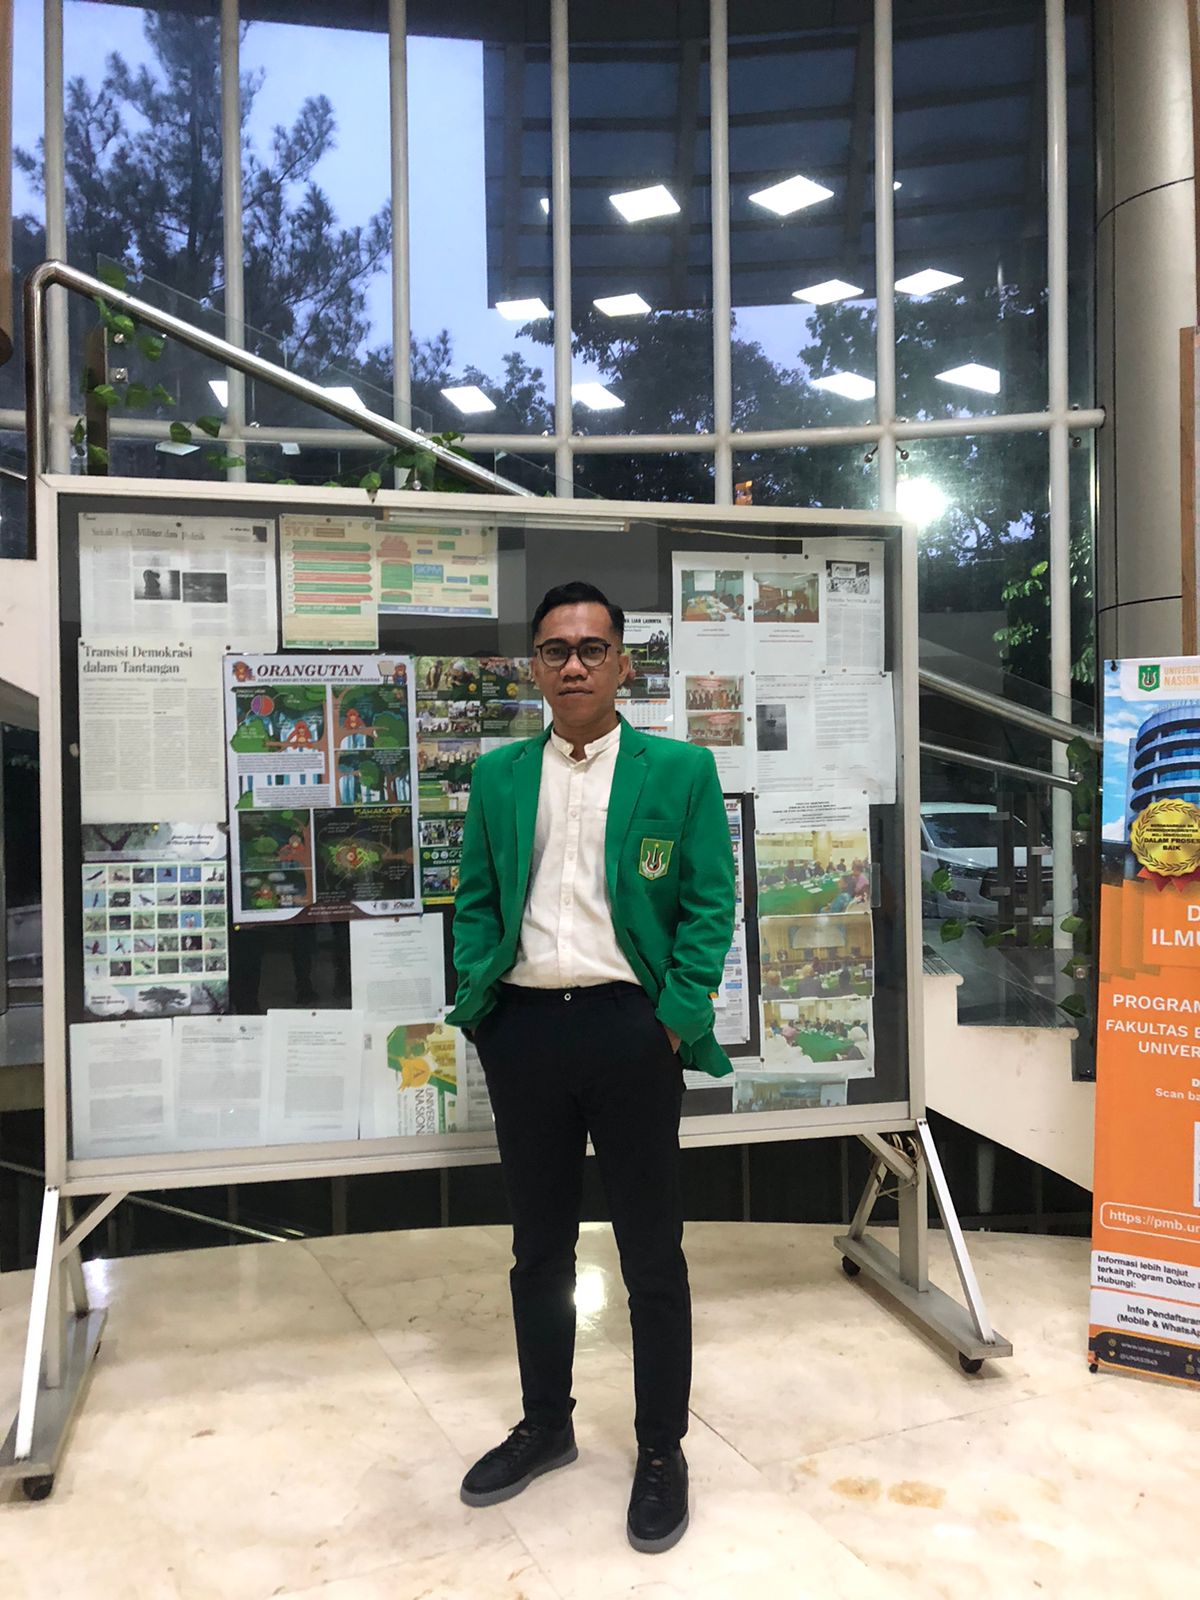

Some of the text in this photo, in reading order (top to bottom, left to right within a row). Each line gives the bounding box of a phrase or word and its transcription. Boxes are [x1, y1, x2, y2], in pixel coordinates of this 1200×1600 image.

[83, 645, 193, 658] Transisi Demokrasi
[82, 660, 180, 674] dalam Tantangan
[256, 663, 363, 677] ORANGUTAN
[1152, 927, 1200, 947] ILM
[1106, 1019, 1189, 1038] FAKULTAS
[1154, 1087, 1185, 1100] Scan
[1097, 1255, 1189, 1277] Informasi lebih lanjut
[1097, 1265, 1125, 1277] terkait
[1126, 1269, 1164, 1282] Program
[1166, 1276, 1196, 1289] Doktor
[1097, 1275, 1137, 1289] Hubungi:
[1127, 1304, 1145, 1315] Info
[1116, 1313, 1150, 1327] (Mobile
[1152, 1320, 1159, 1329] &
